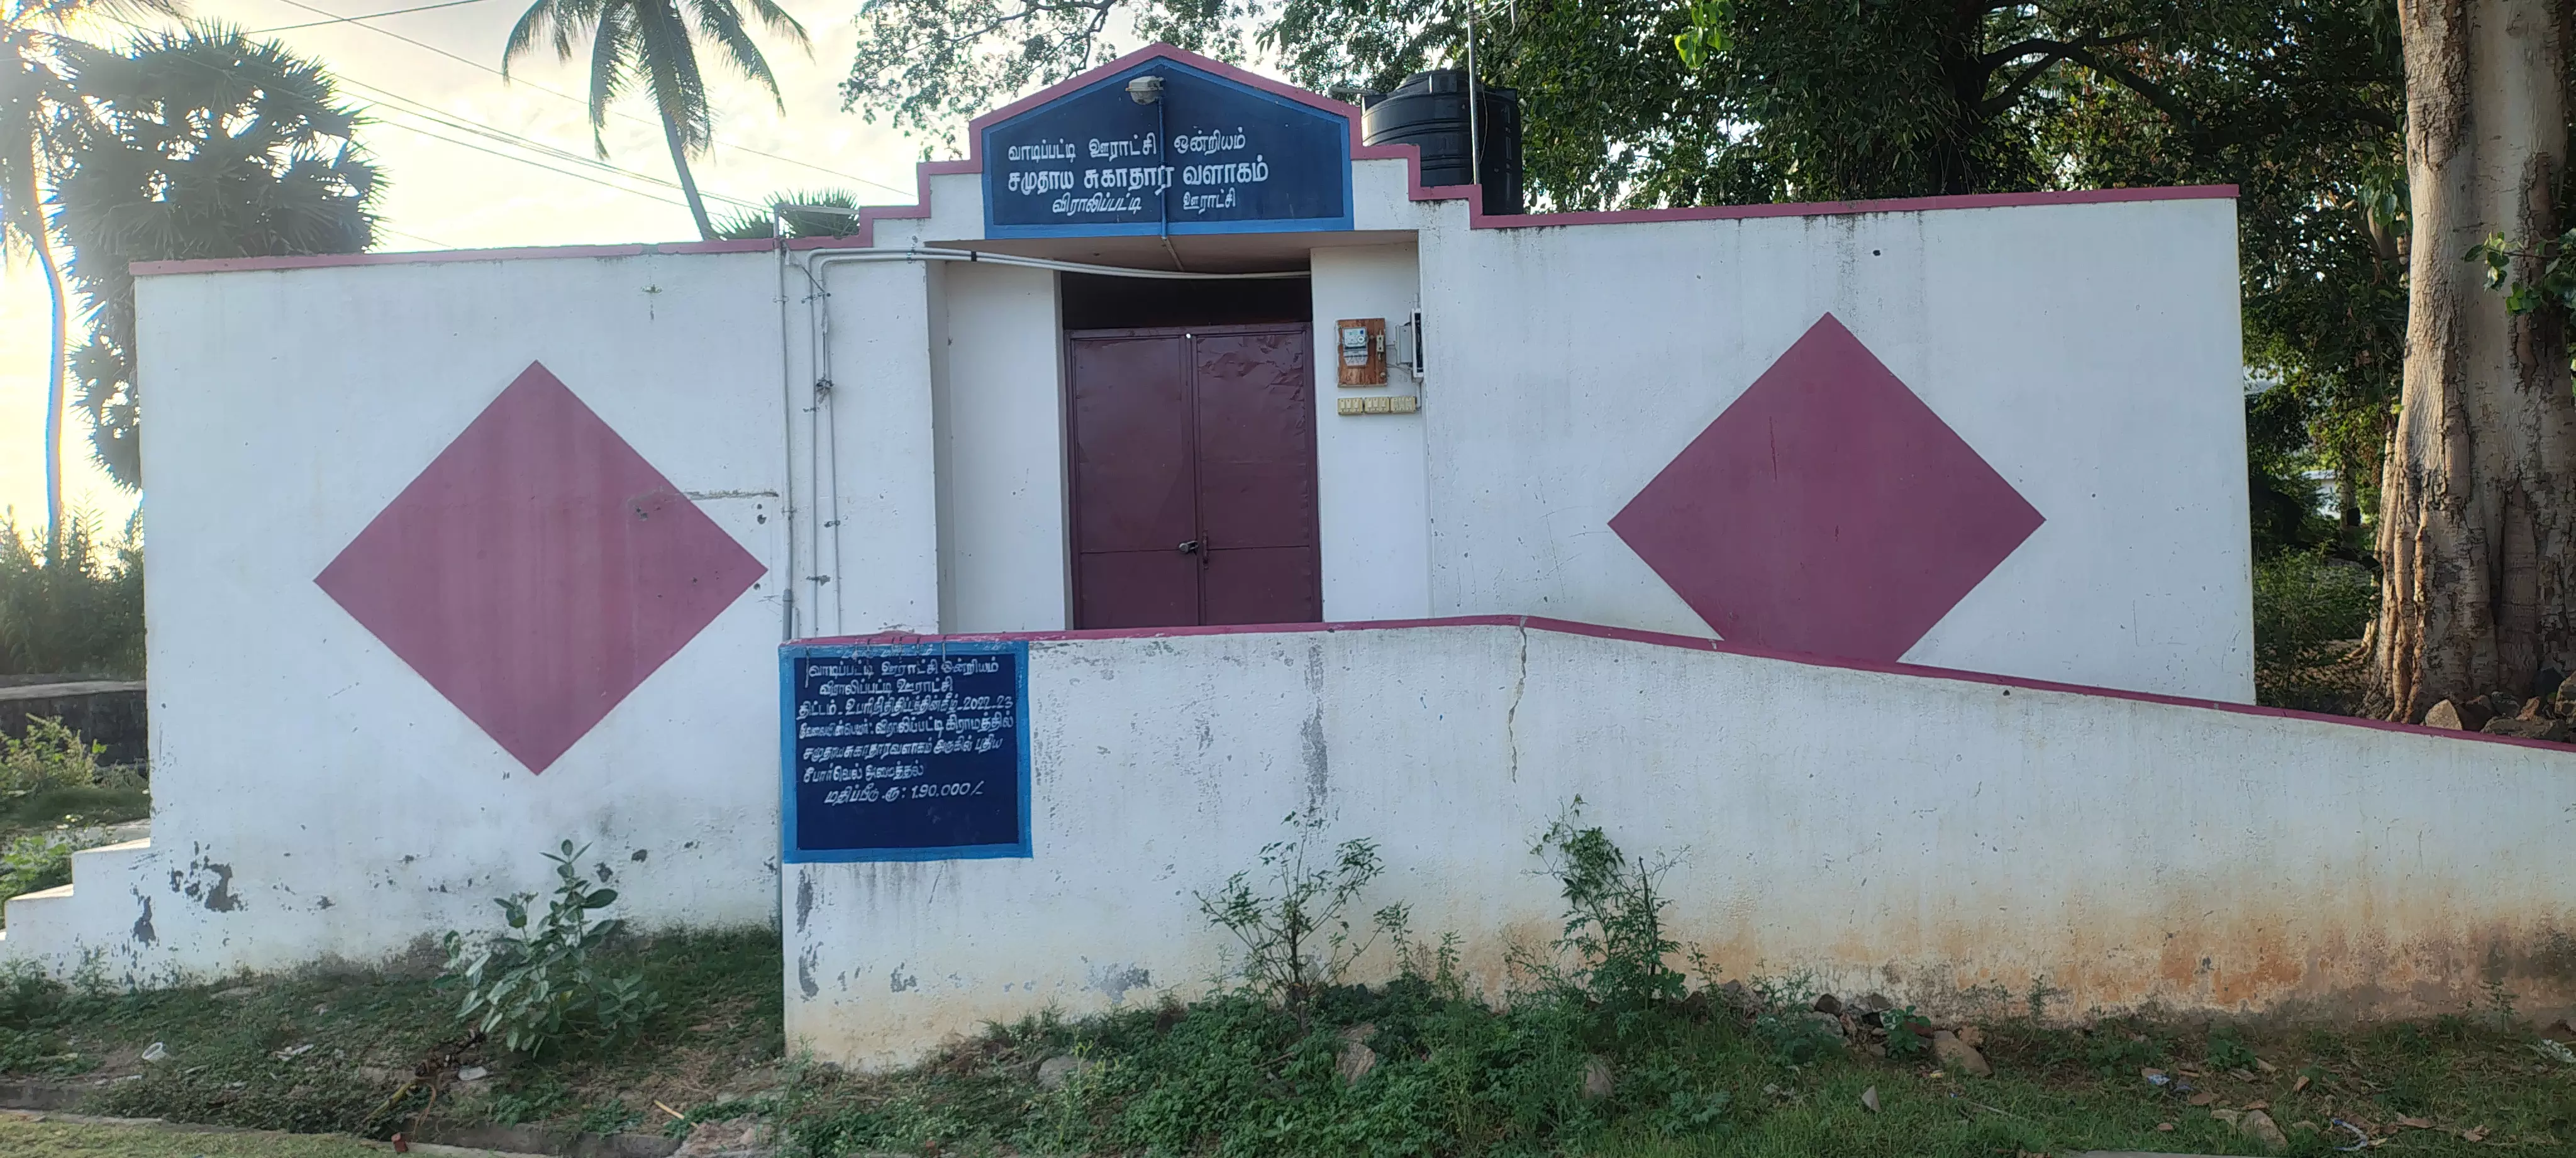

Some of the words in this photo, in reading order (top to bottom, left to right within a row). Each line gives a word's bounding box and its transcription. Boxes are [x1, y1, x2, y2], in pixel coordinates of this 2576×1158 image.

[1008, 138, 1077, 163] வாடிப்பட்டி
[1089, 132, 1157, 162] ஊராட்சி
[1174, 126, 1246, 156] ஒன்றியம்
[1008, 170, 1075, 196] சமுதாய
[1084, 165, 1175, 196] சுகாதார
[1183, 154, 1269, 185] வளாகம்
[1052, 192, 1142, 216] விராலிப்பட்டி
[1183, 187, 1236, 215] ஊராட்சி
[896, 675, 954, 695] ஊராட்சி
